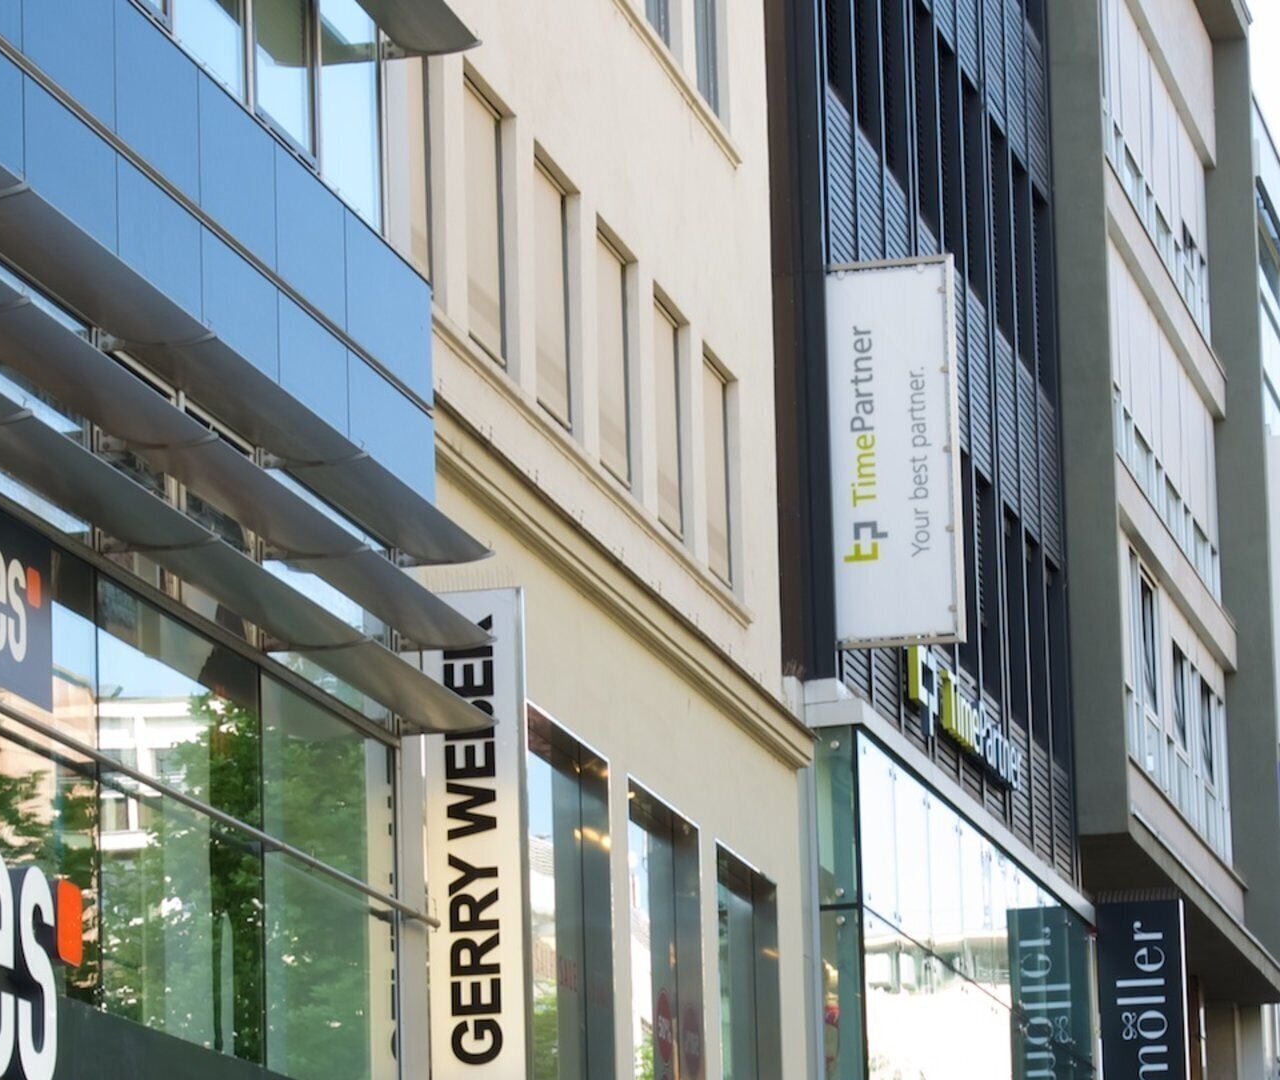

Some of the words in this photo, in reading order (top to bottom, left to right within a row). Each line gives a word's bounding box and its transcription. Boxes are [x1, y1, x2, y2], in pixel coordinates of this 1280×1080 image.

[850, 325, 876, 508] TimePartner
[908, 365, 932, 448] partner.
[908, 454, 929, 500] best
[911, 507, 931, 558] Your
[447, 853, 503, 1066] GERRY
